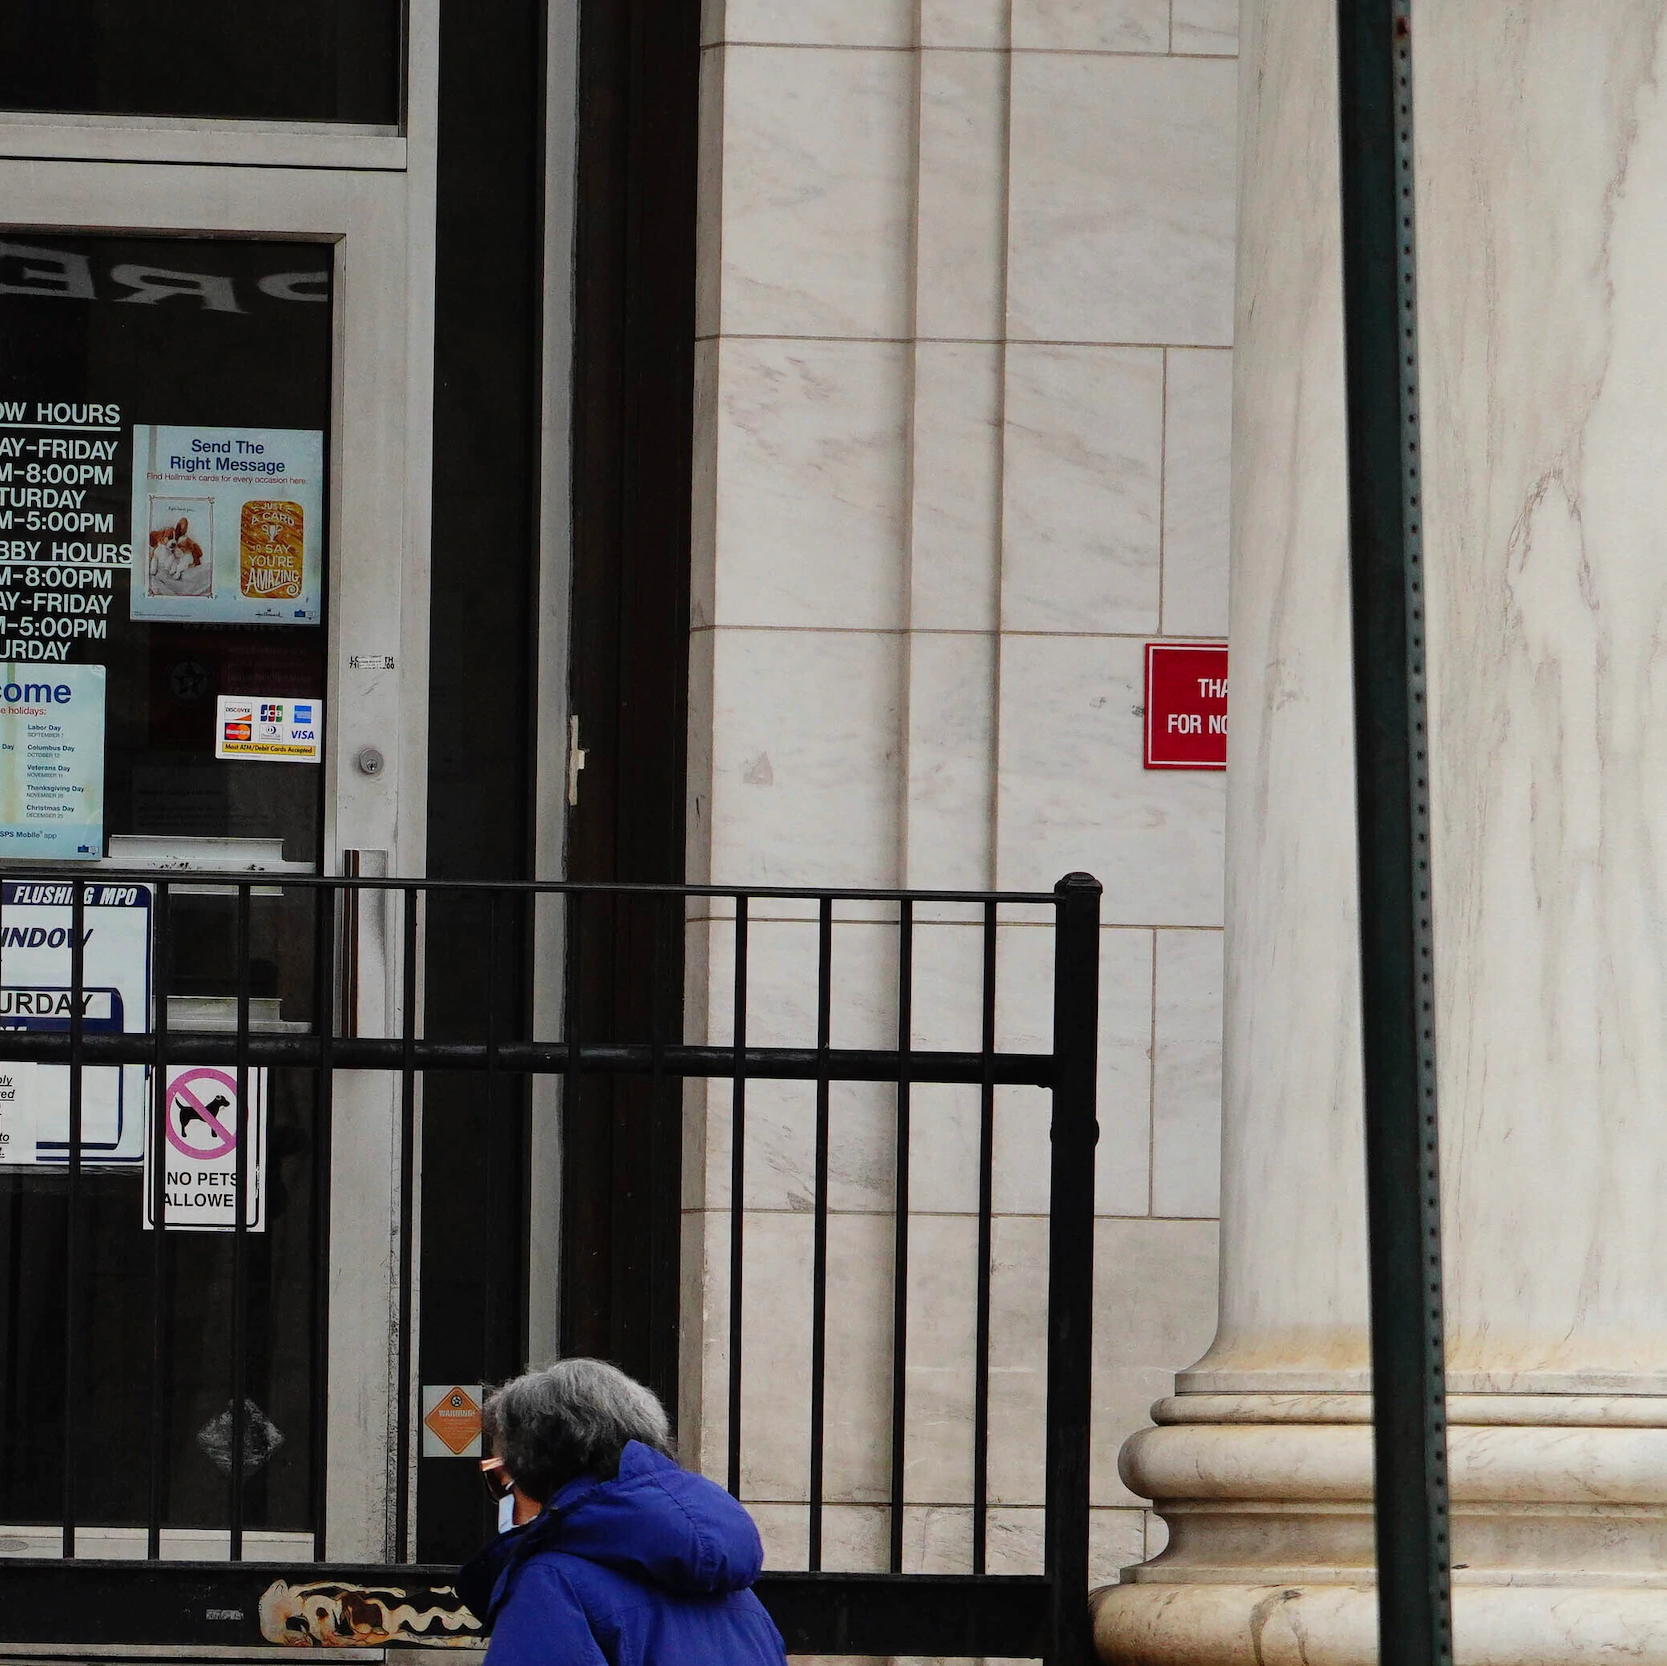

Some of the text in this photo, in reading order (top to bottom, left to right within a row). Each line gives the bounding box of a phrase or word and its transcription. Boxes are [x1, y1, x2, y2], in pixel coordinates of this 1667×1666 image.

[37, 402, 121, 424] HOURS
[191, 439, 265, 454] Send The
[170, 456, 286, 475] Right Message
[146, 472, 163, 480] Find
[164, 473, 197, 481] Hallmark
[198, 474, 219, 482] cards
[221, 474, 232, 482] for
[233, 476, 254, 485] every
[255, 476, 288, 484] occasion
[263, 502, 284, 510] JUST
[262, 512, 295, 526] CARD
[51, 542, 133, 563] HOURS
[265, 544, 292, 554] SAY
[248, 555, 294, 568] YOU'RE
[244, 567, 300, 594] AMAZING
[8, 706, 47, 716] holidays:
[48, 724, 61, 732] Day
[1167, 714, 1202, 734] FOR
[291, 730, 315, 740] VISA
[240, 744, 270, 752] ATM/Debit
[27, 784, 84, 793] Thanksgiving Day
[62, 805, 75, 813] Day
[13, 886, 138, 906] FLUSHIG MPO
[167, 1172, 237, 1187] NO PETS
[165, 1193, 234, 1207] ALLOWE
